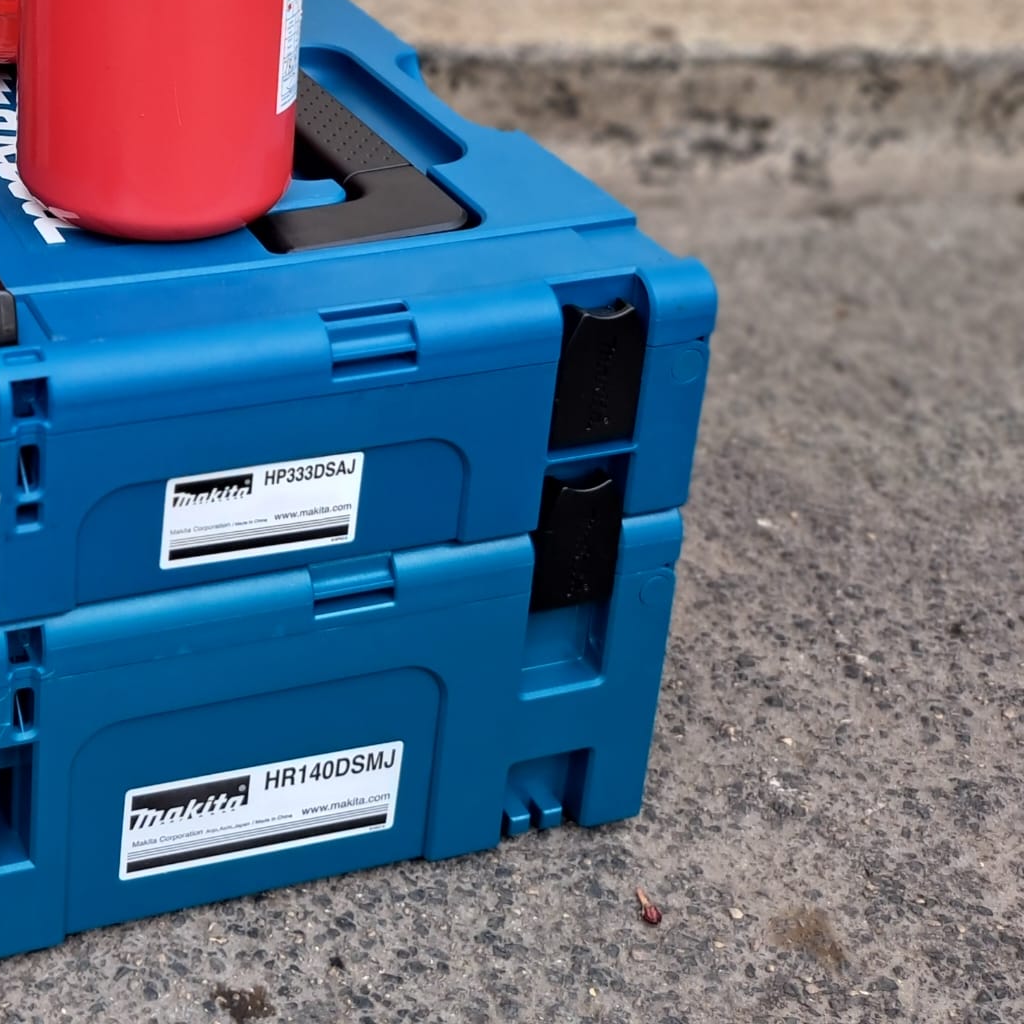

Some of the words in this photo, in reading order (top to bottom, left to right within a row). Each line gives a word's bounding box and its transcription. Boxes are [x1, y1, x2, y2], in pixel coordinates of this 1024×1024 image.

[172, 479, 251, 508] makita
[264, 458, 356, 487] HP333DSAJ
[170, 526, 192, 536] Makita
[192, 522, 232, 533] Corporation
[274, 502, 353, 522] www.makita.com
[129, 790, 248, 831] makita
[264, 749, 396, 791] HR140DSMJ
[132, 836, 158, 848] Makita
[158, 828, 204, 844] Corporation
[301, 791, 390, 816] www.makita.com
